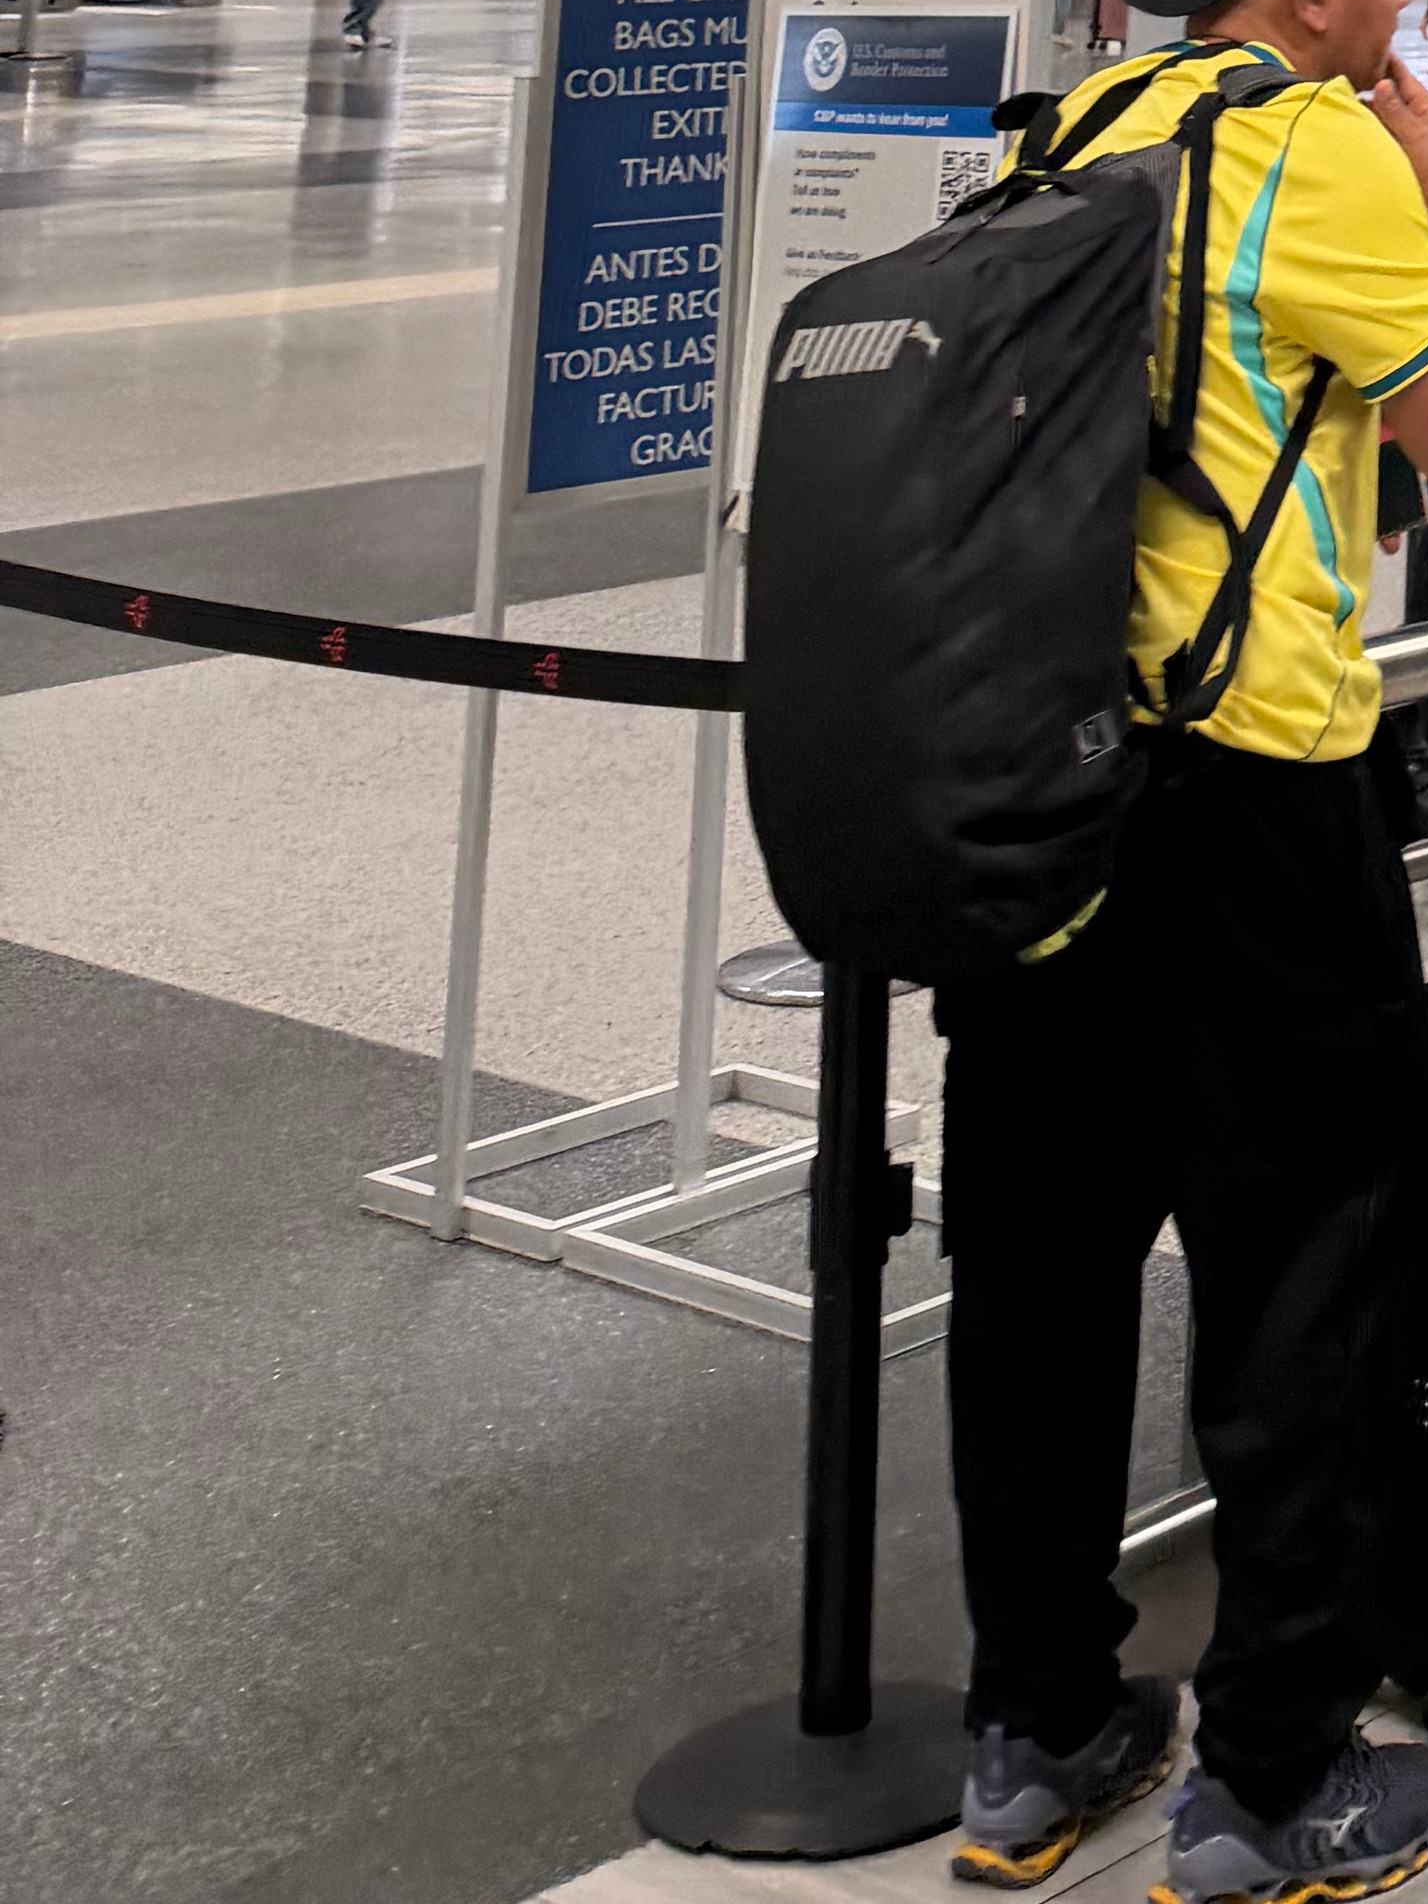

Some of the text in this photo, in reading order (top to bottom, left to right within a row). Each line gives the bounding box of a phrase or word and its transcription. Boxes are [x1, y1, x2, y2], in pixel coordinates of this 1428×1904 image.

[614, 17, 697, 51] BAGS
[584, 242, 722, 285] ANTES D
[577, 294, 659, 333] DEBE
[543, 333, 716, 383] TODAS LAS
[775, 317, 914, 383] PUMA
